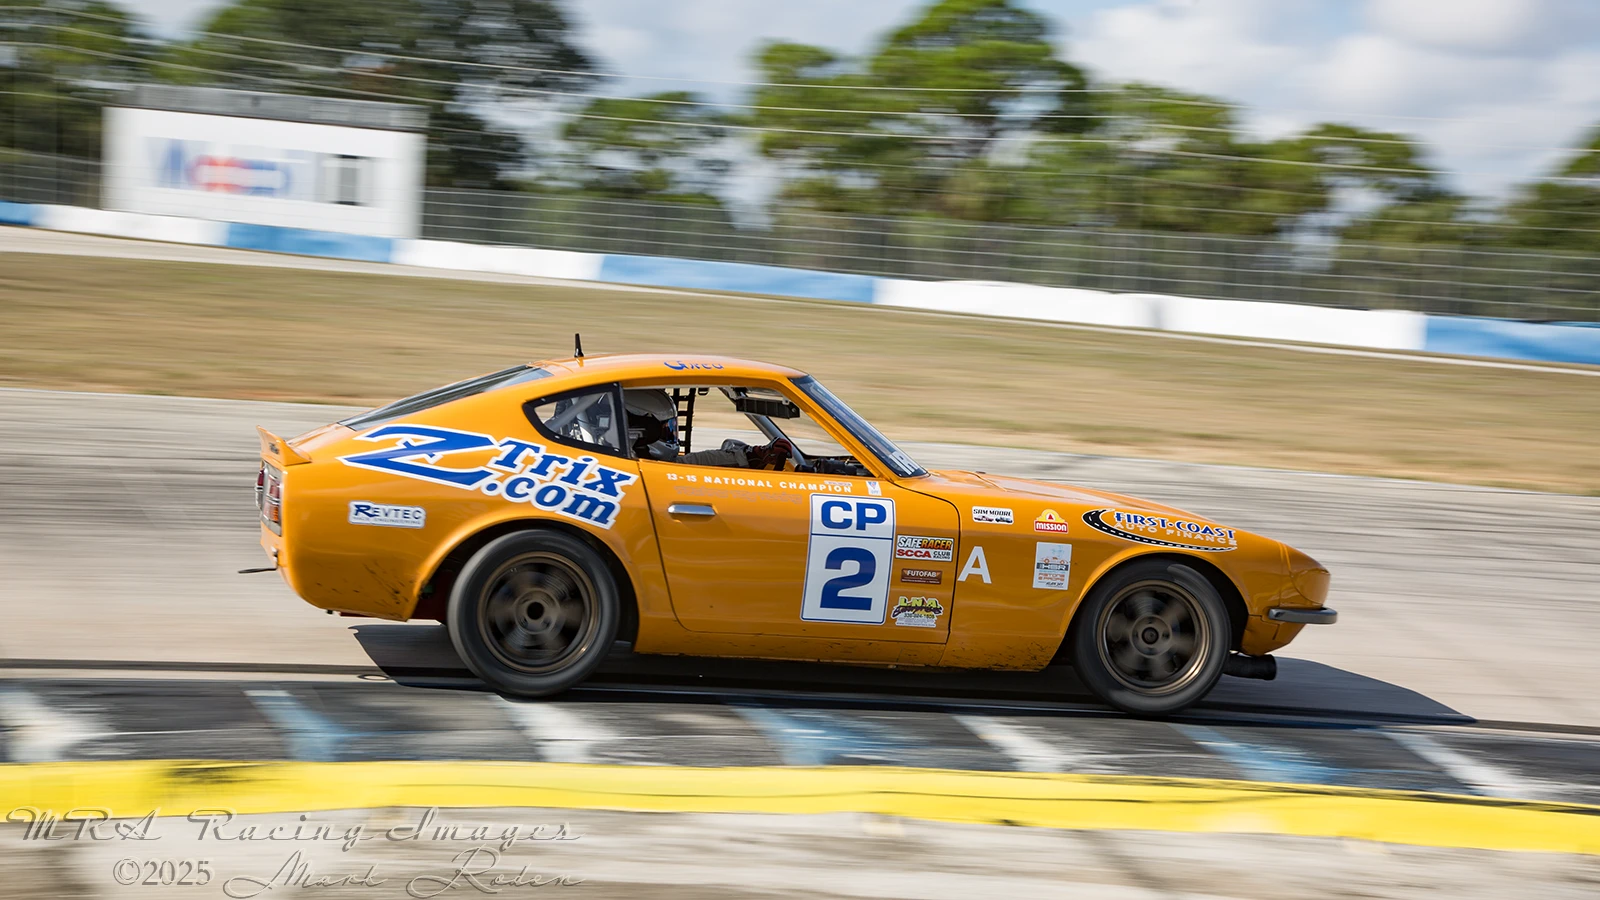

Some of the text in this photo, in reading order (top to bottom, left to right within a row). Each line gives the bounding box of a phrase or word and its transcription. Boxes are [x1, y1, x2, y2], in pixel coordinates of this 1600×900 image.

[704, 475, 773, 488] NATIONAL
[779, 481, 852, 493] CHAMPION
[484, 475, 616, 526] .com
[820, 500, 887, 531] CP
[898, 536, 953, 550] SAFERACER
[1113, 521, 1238, 546] AUTO FINANCE
[896, 548, 932, 559] SCCA
[957, 545, 992, 584] A
[819, 546, 877, 612] 2
[906, 569, 937, 578] FUTOFAB
